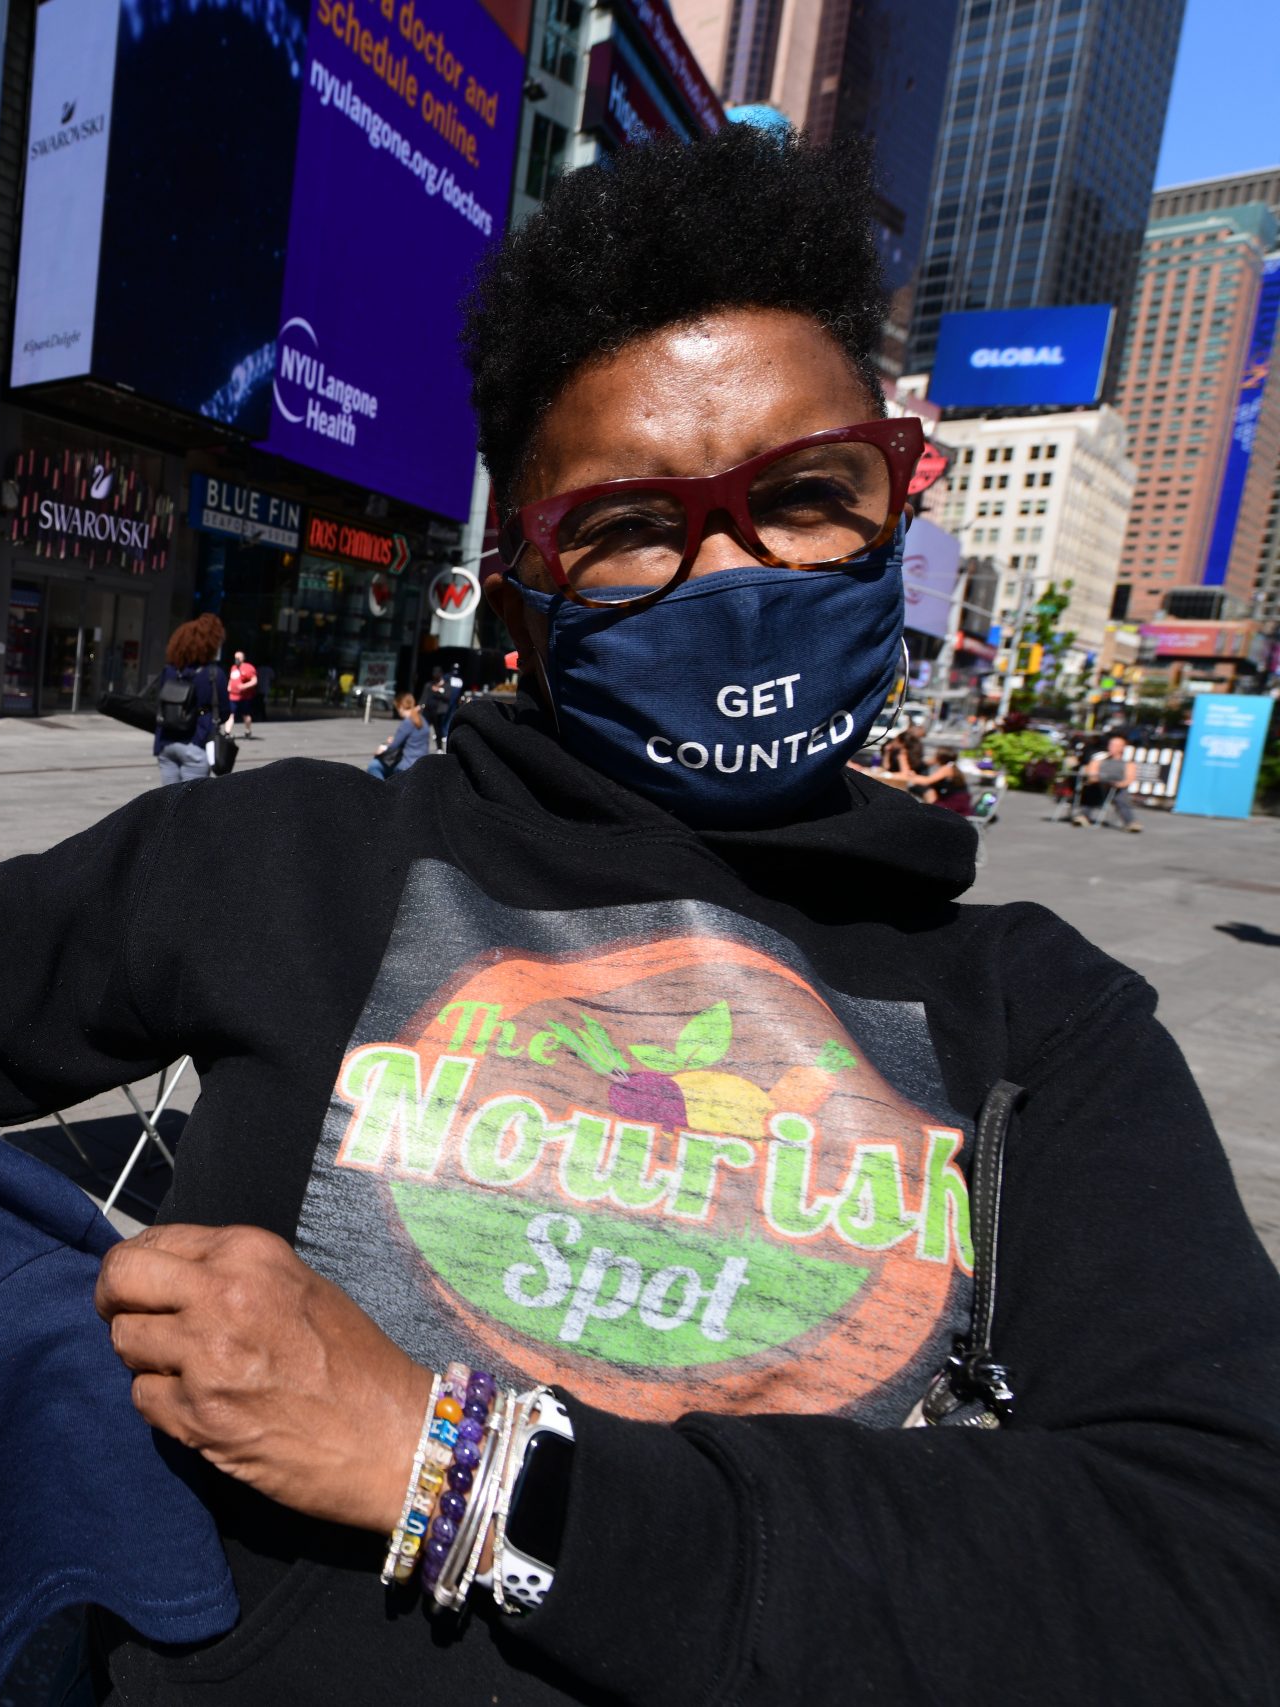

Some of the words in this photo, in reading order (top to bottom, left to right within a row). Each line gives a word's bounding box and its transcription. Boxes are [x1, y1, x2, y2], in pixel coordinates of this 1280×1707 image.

[318, 0, 417, 108] schedule
[422, 90, 479, 169] online.
[400, 0, 463, 90] doctor
[465, 76, 498, 128] and
[31, 114, 105, 160] SWAROVSKI
[311, 59, 492, 236] nyulangone.org/doctors
[281, 344, 318, 391] NYU
[317, 363, 378, 419] Langone
[969, 346, 1065, 368] GLOBAL
[306, 398, 356, 447] Health
[38, 500, 150, 549] SWAROVSKI
[206, 478, 261, 519] BLUE
[269, 497, 301, 529] FIN
[310, 518, 337, 551] DOS
[339, 525, 394, 565] CAMINOS
[716, 673, 801, 718] GET
[646, 710, 854, 774] COUNTED
[437, 998, 566, 1066] The
[336, 1042, 976, 1277] Nourish
[502, 1211, 750, 1344] Spot
